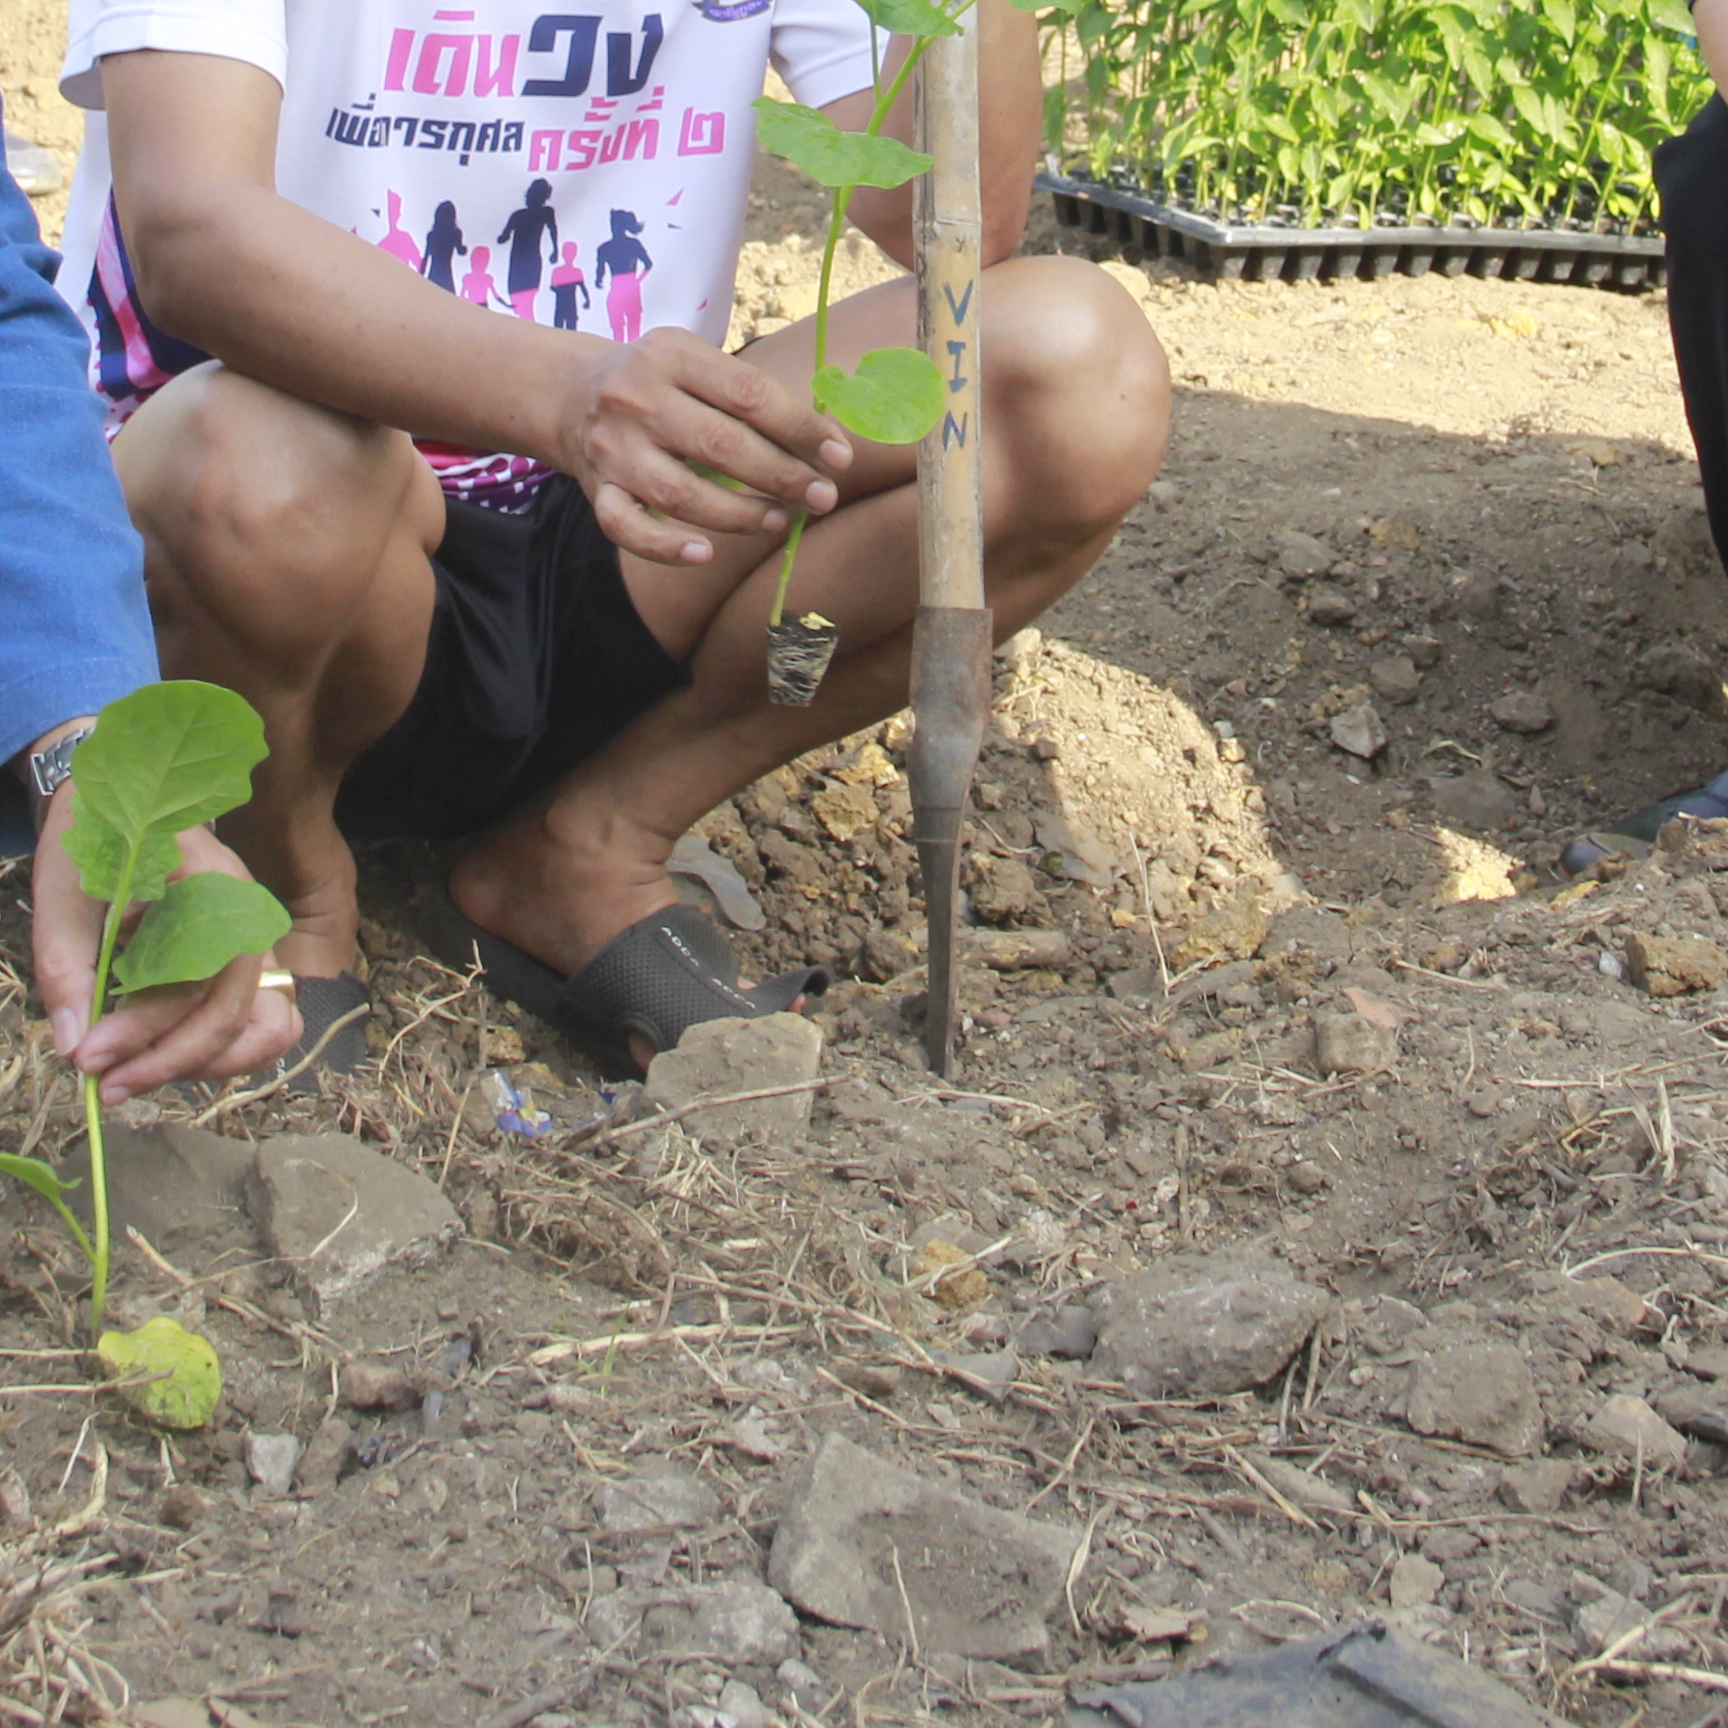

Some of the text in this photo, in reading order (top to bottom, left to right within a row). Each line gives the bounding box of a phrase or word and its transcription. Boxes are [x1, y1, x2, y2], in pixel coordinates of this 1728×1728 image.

[528, 86, 665, 172] ครั้งที่
[678, 106, 725, 157] ๒
